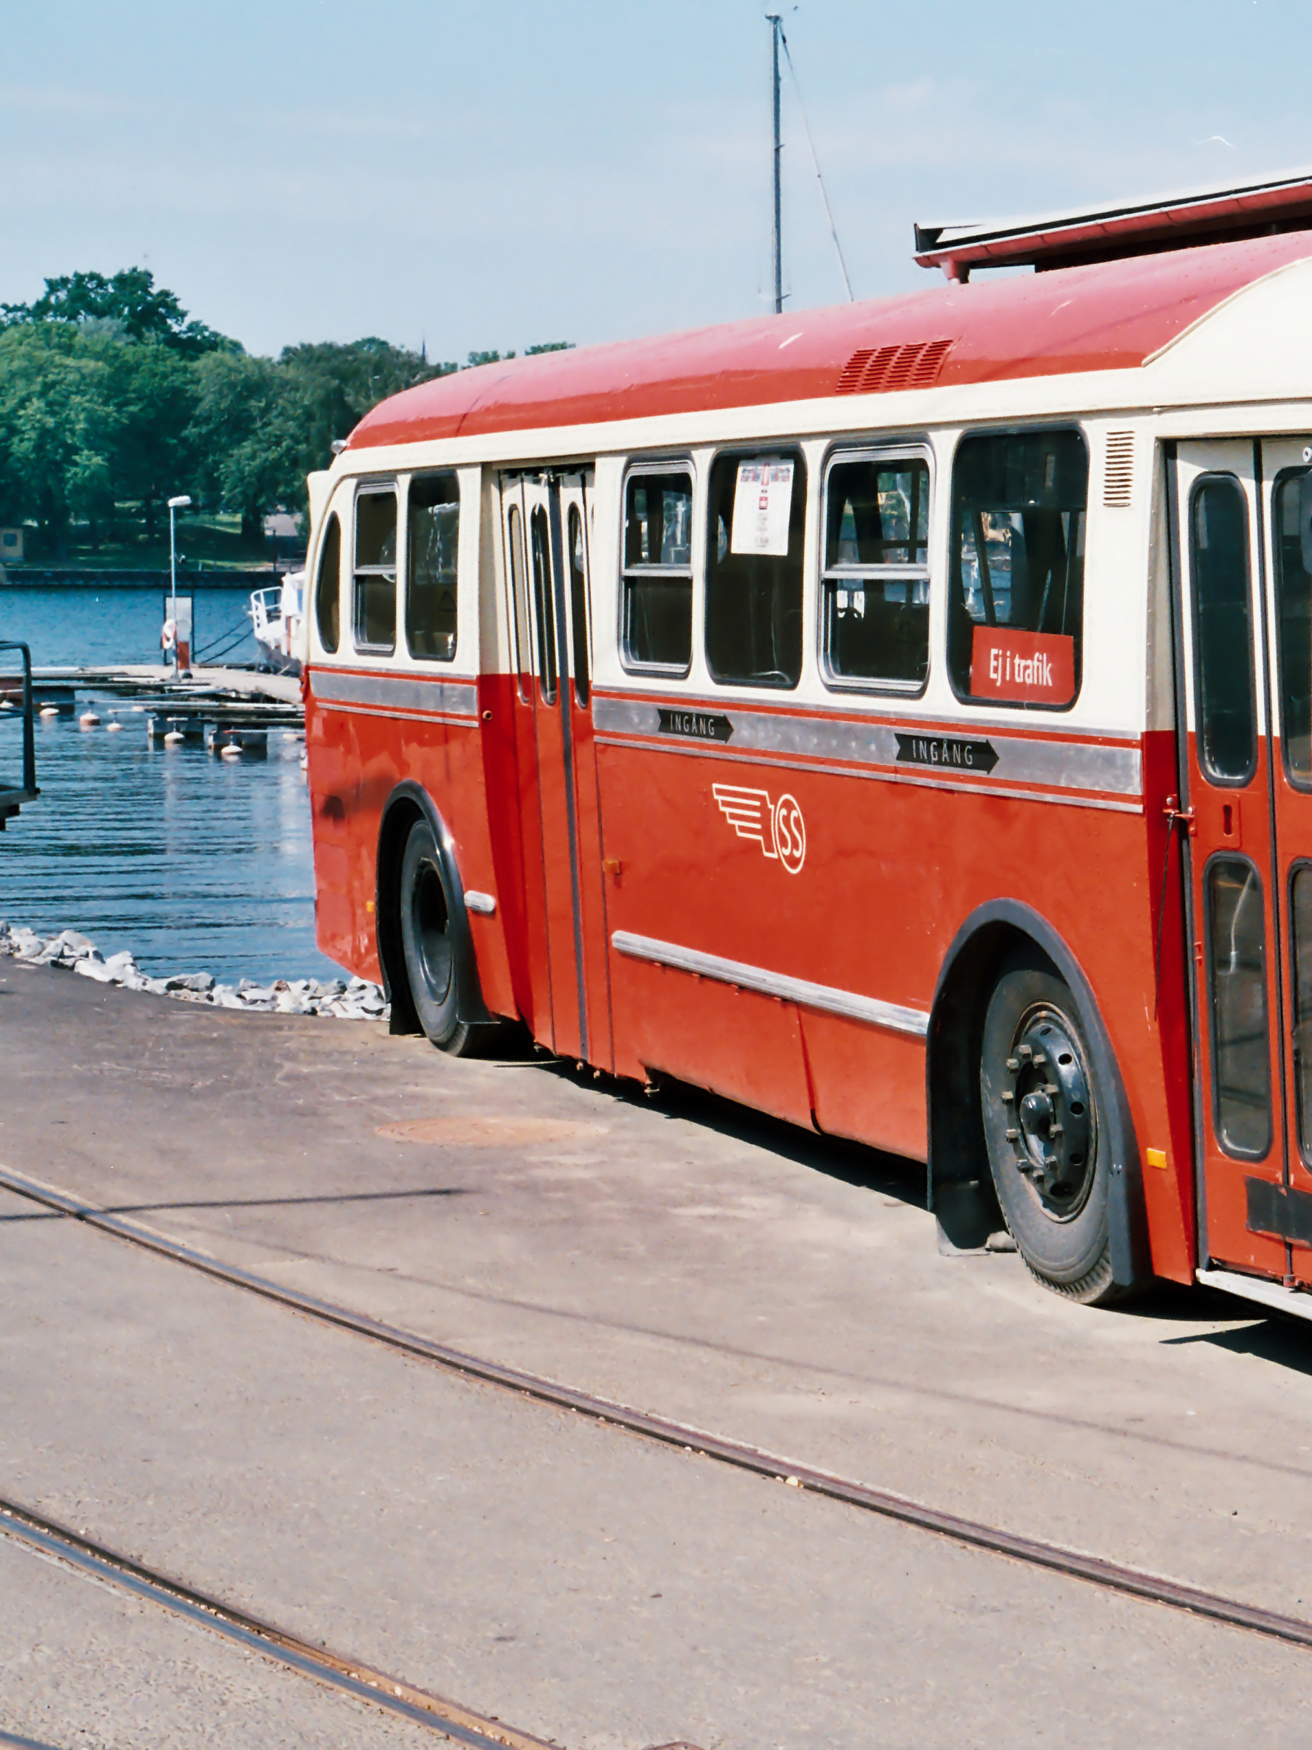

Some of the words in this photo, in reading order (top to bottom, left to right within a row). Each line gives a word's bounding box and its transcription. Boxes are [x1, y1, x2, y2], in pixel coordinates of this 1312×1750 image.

[989, 648, 1002, 687] Ej
[1006, 650, 1011, 681] i
[1013, 652, 1053, 687] trafik
[670, 713, 715, 736] INGÅNG
[912, 739, 973, 766] INGÅNG
